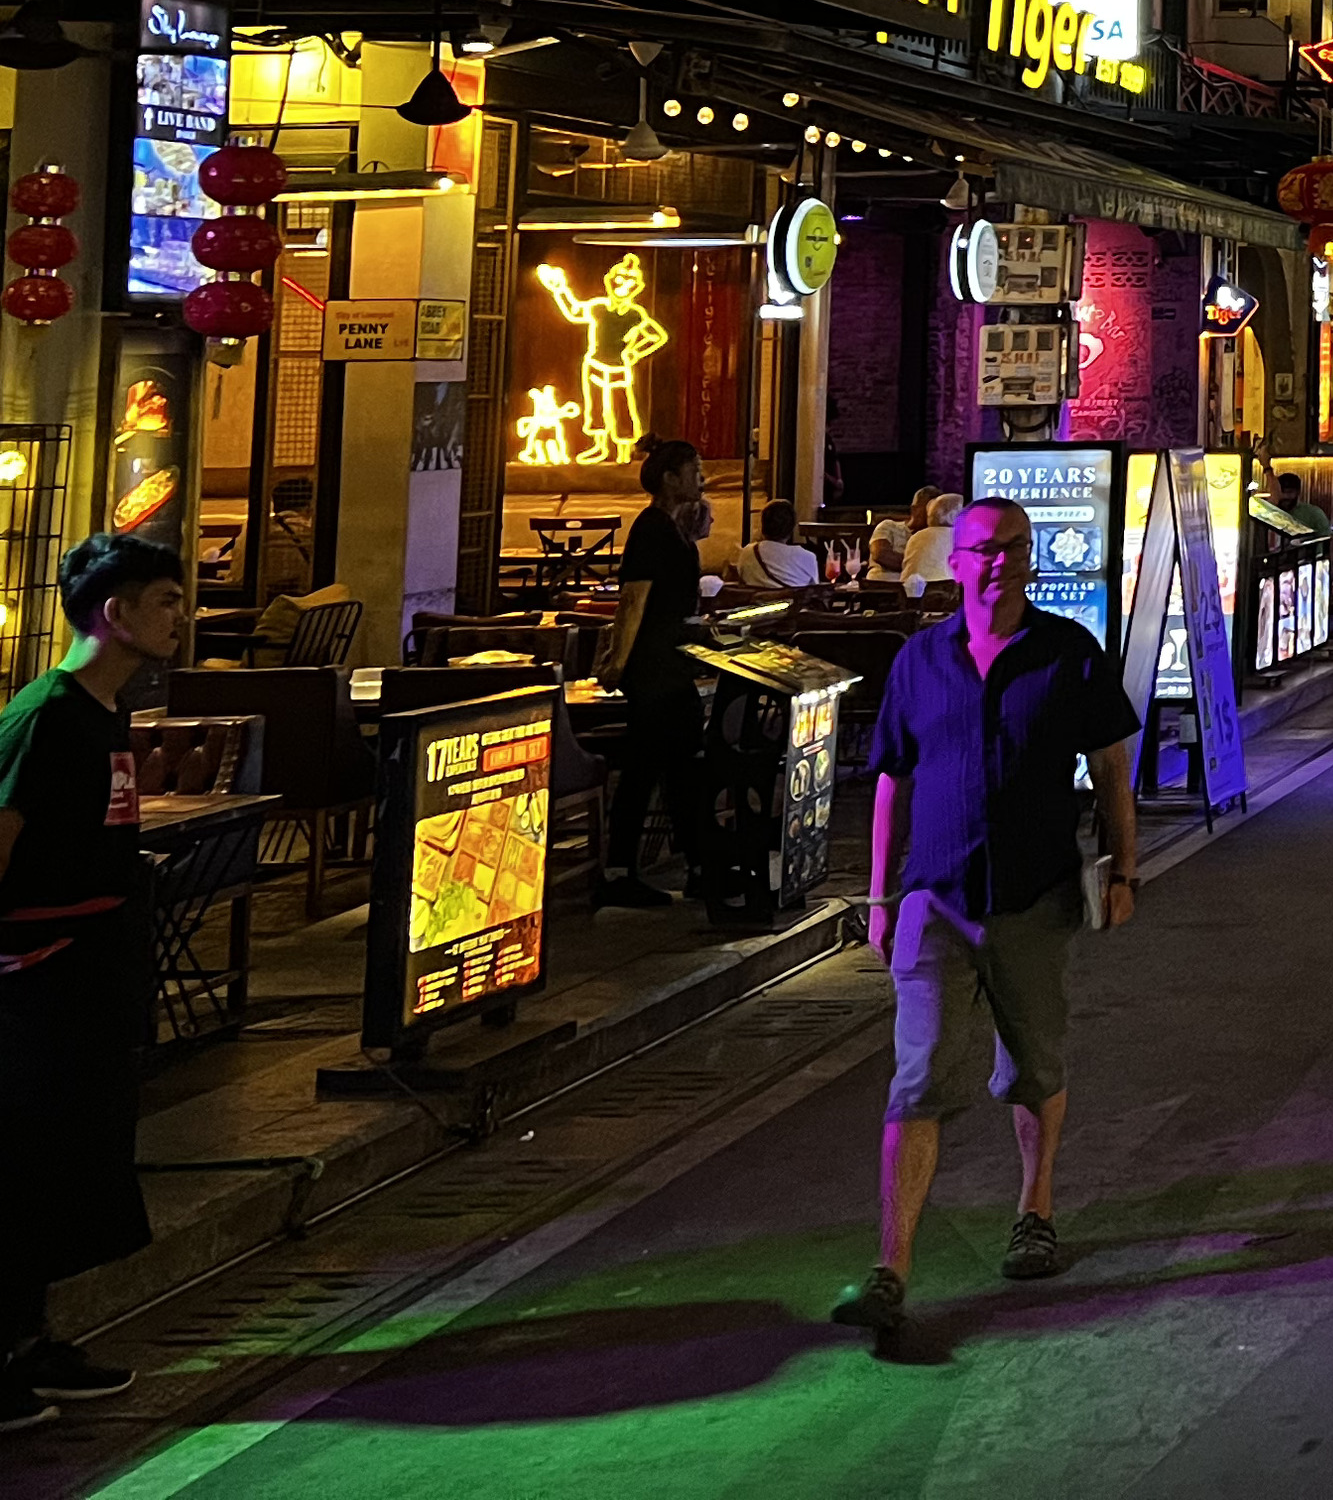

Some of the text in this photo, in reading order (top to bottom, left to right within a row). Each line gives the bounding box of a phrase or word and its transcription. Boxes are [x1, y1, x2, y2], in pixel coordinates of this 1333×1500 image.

[1091, 20, 1123, 40] SA
[157, 110, 184, 128] LIVE
[1205, 305, 1243, 326] Tiger
[338, 323, 389, 335] PENNY
[345, 338, 383, 349] LANE
[983, 467, 1096, 485] 20 YEARS
[987, 486, 1093, 500] EXPERIENCE
